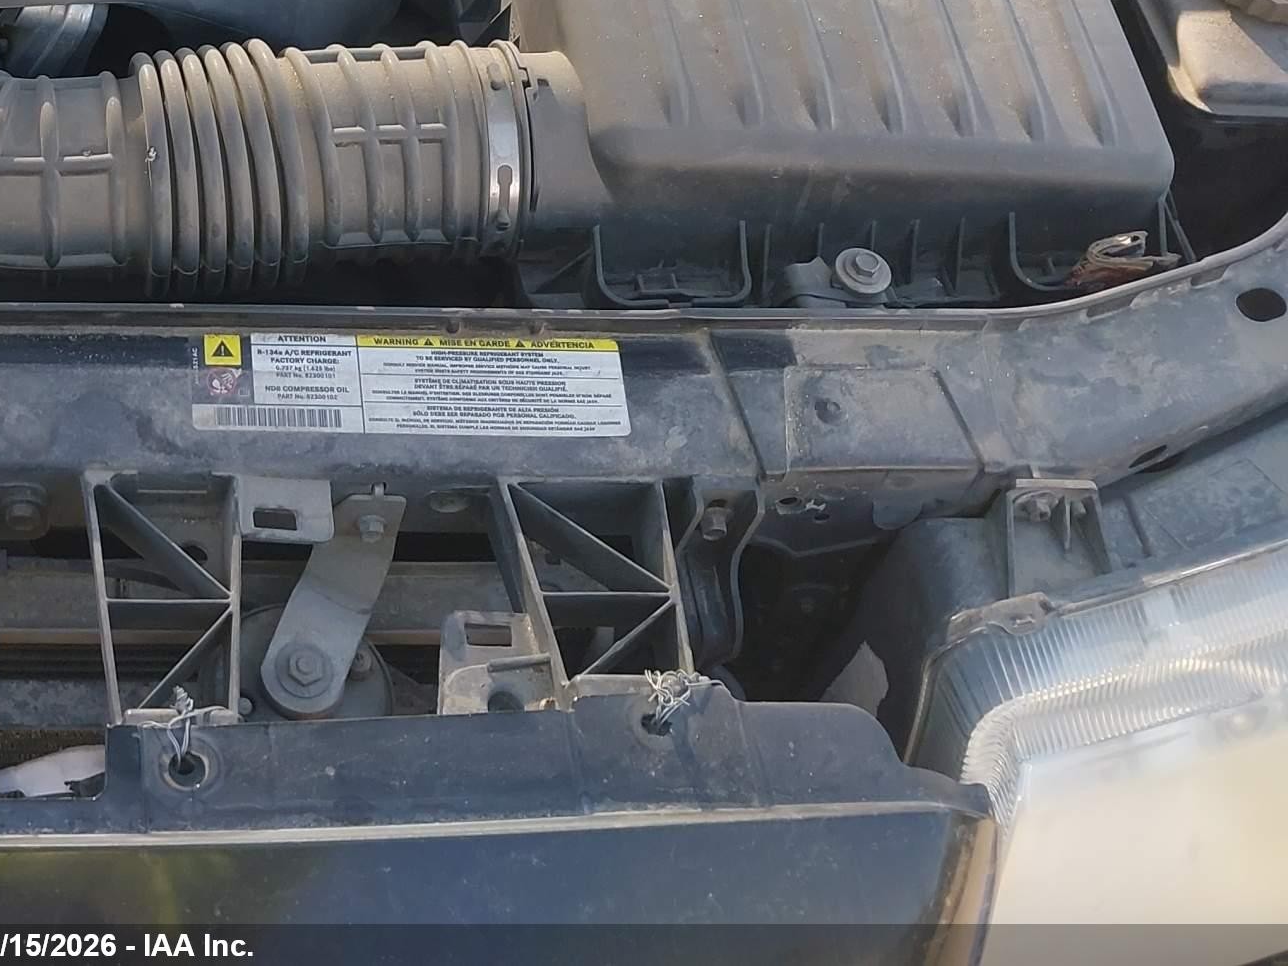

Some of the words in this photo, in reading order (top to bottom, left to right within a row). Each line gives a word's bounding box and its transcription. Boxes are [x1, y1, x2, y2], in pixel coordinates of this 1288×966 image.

[373, 338, 419, 346] WARNING
[440, 339, 462, 347] MISE
[464, 339, 476, 347] EN
[478, 340, 511, 348] GARDE
[530, 341, 594, 350] ADVERTENCIA
